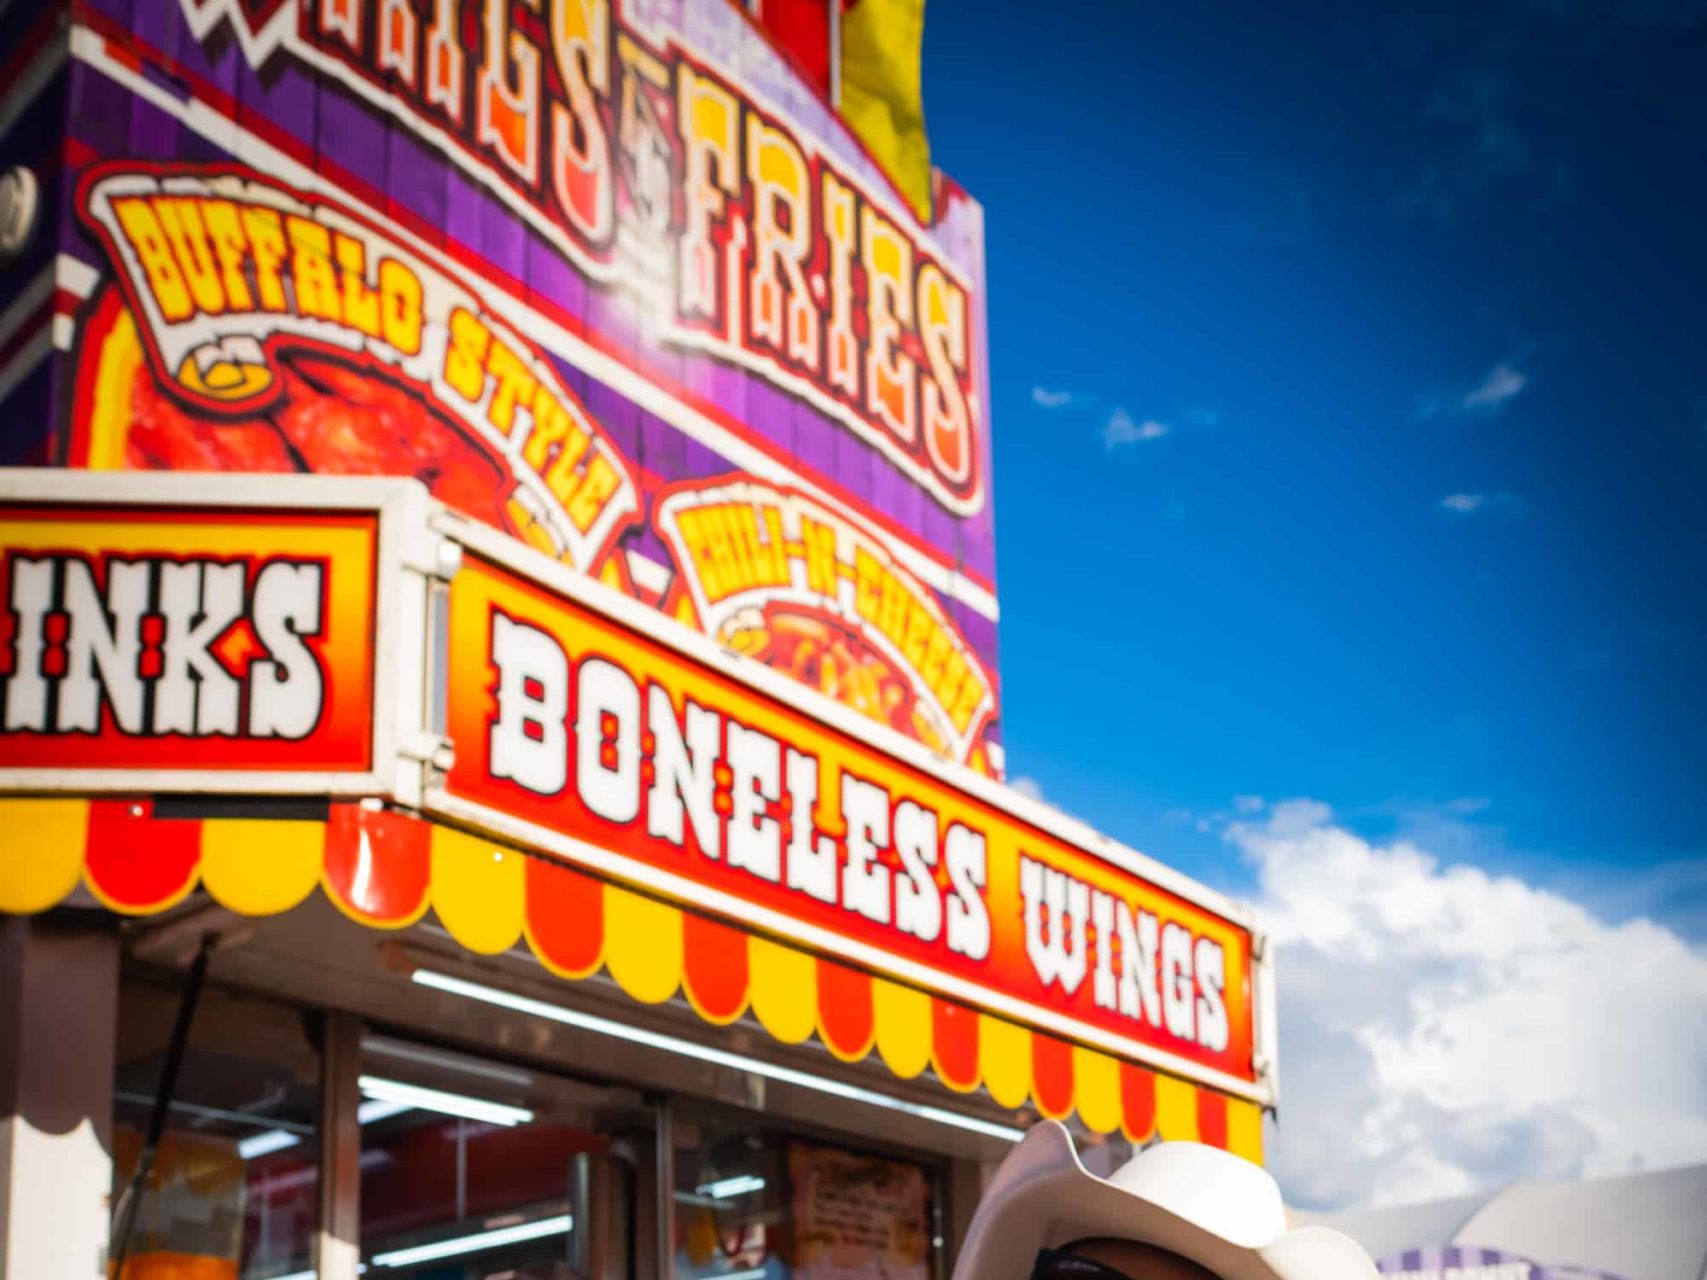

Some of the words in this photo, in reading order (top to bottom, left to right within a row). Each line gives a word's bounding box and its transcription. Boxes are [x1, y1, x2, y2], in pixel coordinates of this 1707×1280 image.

[112, 197, 424, 356] BUFFALO
[443, 305, 622, 536] STYLE
[676, 62, 971, 485] FRIES
[4, 557, 323, 740] INKS
[489, 612, 991, 961] BONELESS
[1018, 855, 1229, 1053] WINGS
